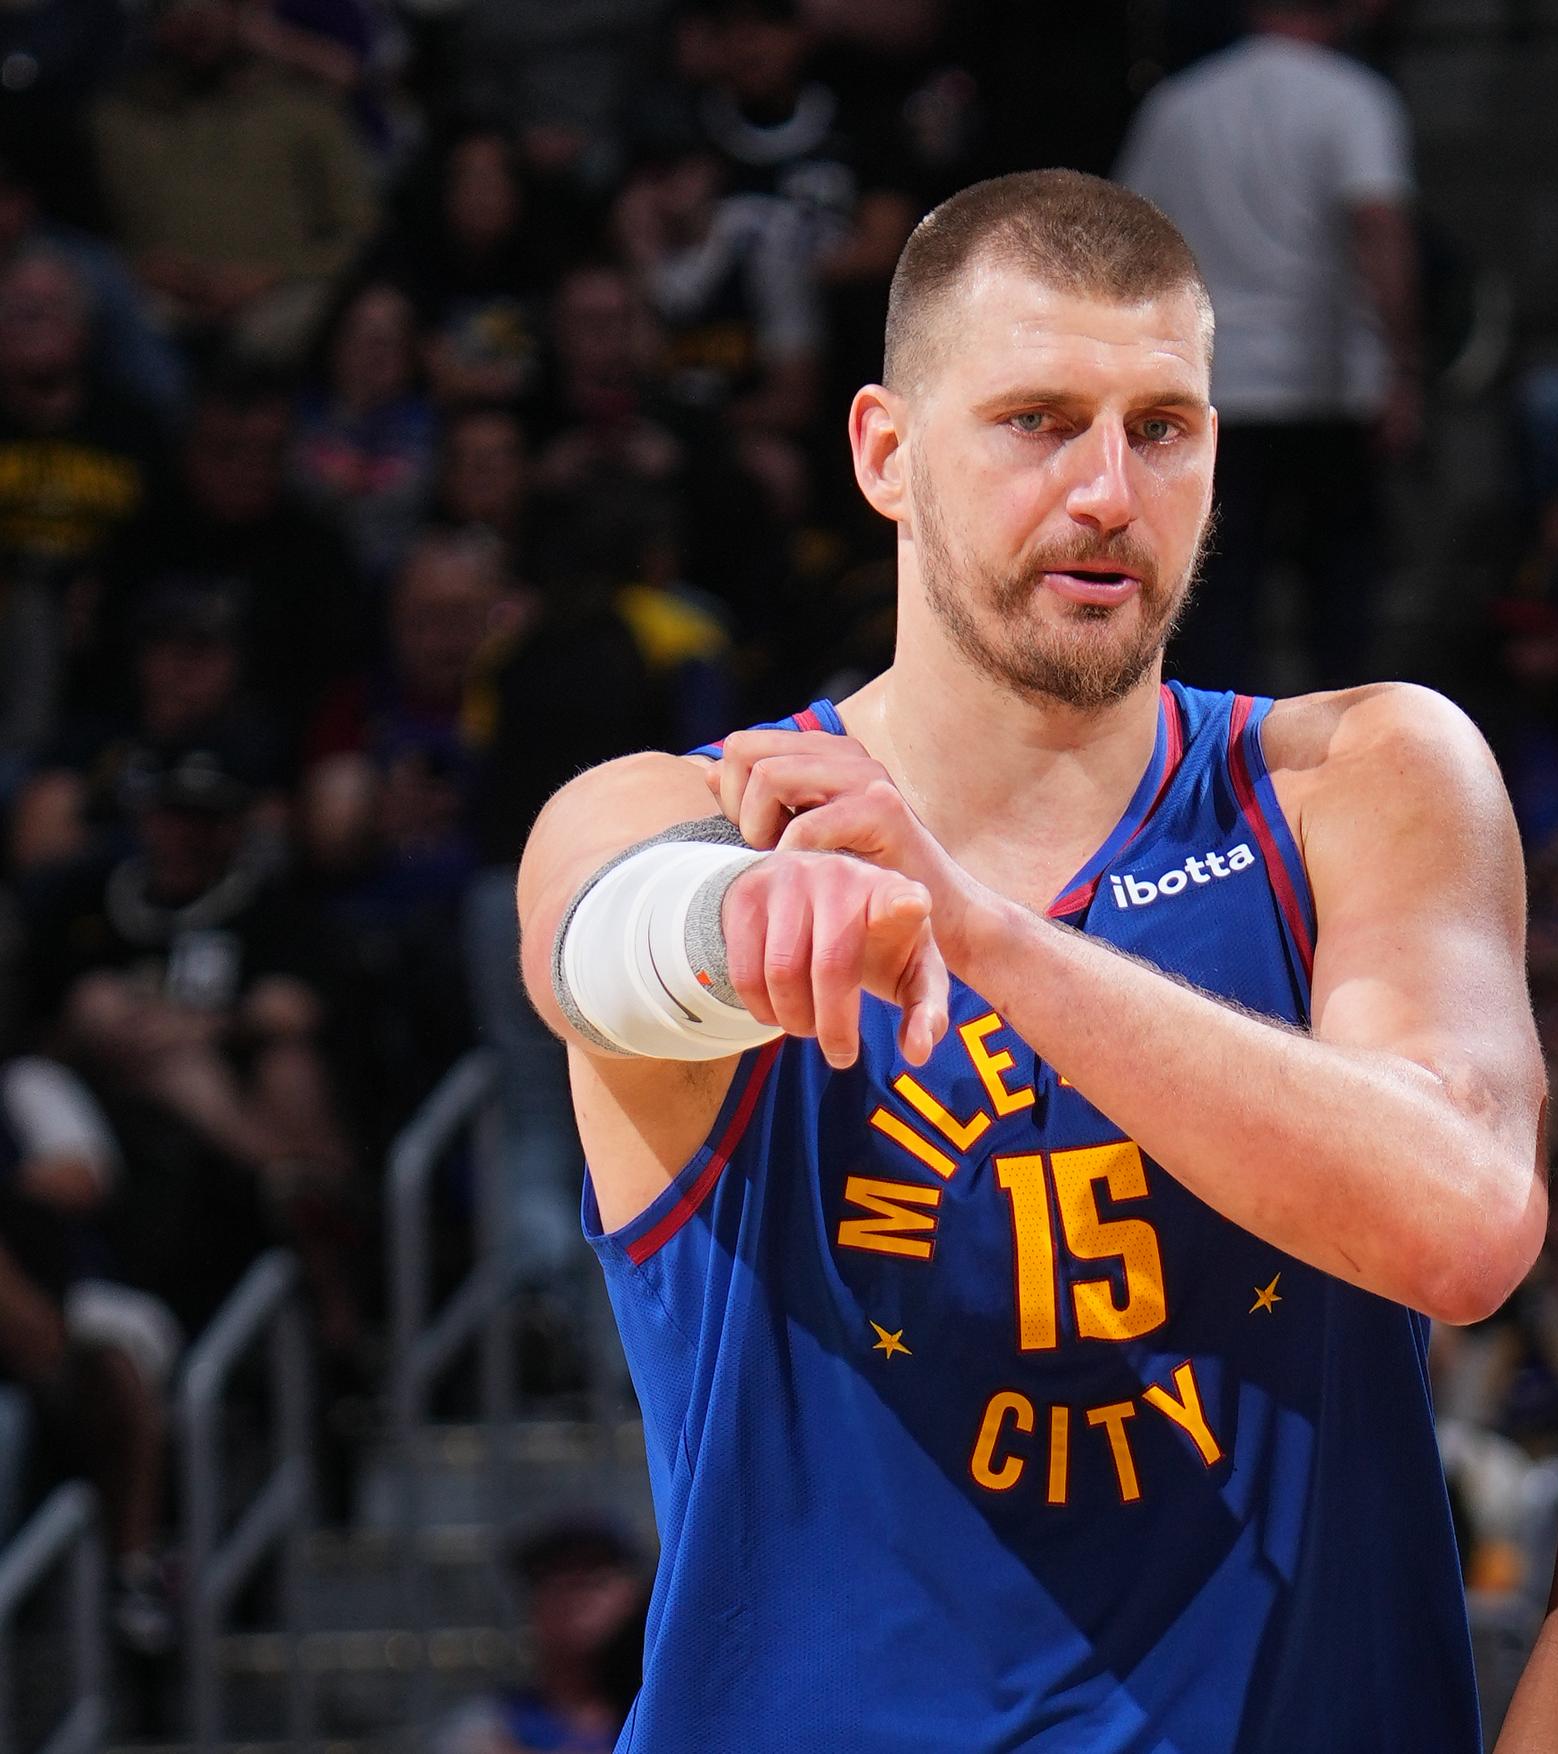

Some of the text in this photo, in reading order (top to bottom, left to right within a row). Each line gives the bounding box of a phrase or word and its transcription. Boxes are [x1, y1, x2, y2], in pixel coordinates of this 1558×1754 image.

[1111, 842, 1254, 909] ibotta
[836, 1010, 1036, 1262] MILE
[994, 1140, 1167, 1353] 15
[969, 1360, 1226, 1504] CITY
